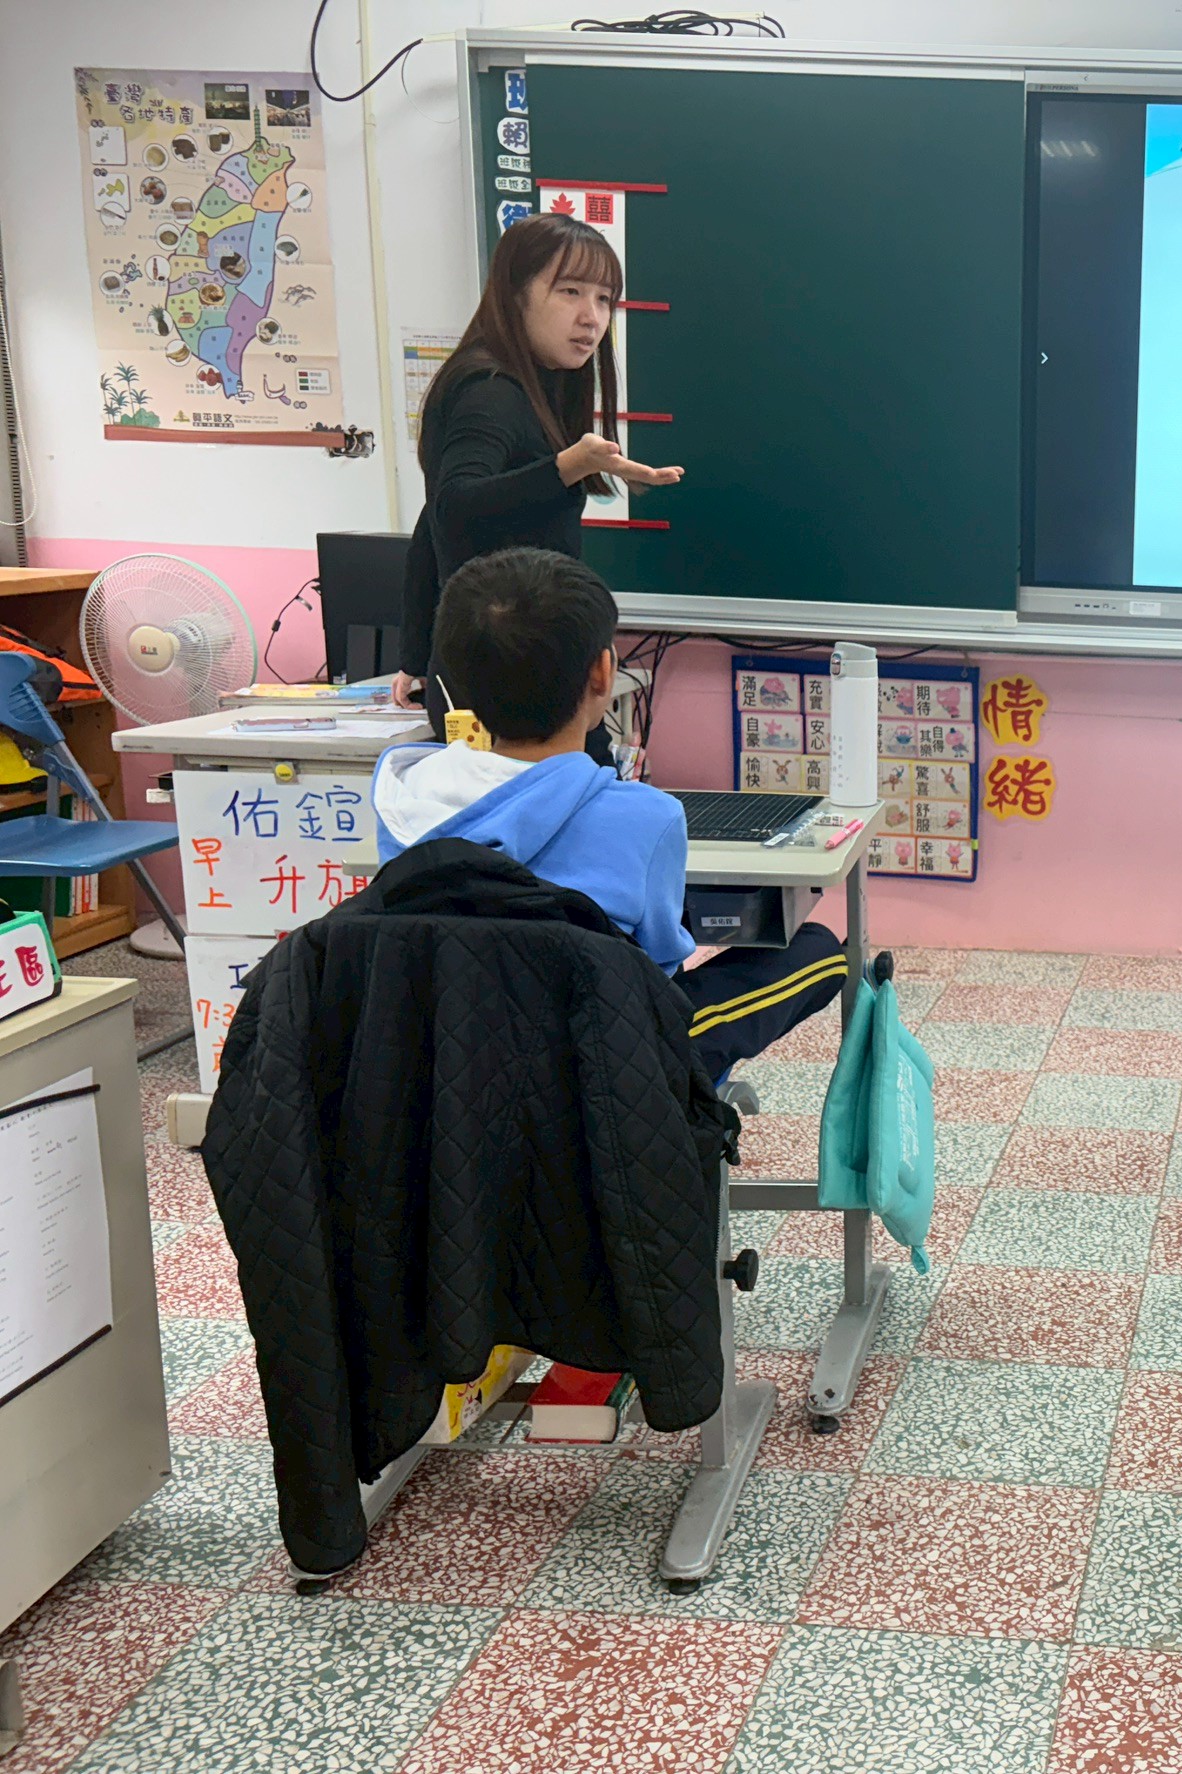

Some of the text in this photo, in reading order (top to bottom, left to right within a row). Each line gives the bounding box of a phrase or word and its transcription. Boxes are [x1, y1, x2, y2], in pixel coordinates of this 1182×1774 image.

[587, 195, 612, 222] 囍
[742, 675, 757, 707] 滿足
[809, 680, 824, 710] 充實
[916, 685, 931, 716] 期待
[746, 717, 760, 748] 自豪
[810, 720, 825, 751] 安心
[982, 678, 1052, 816] 情緒
[745, 757, 760, 788] 愉快
[806, 759, 821, 790] 高興
[916, 765, 930, 797] 驚喜
[916, 803, 930, 832] 舒服
[868, 839, 882, 868] 平靜
[919, 841, 934, 871] 幸福
[192, 837, 232, 908] 早上
